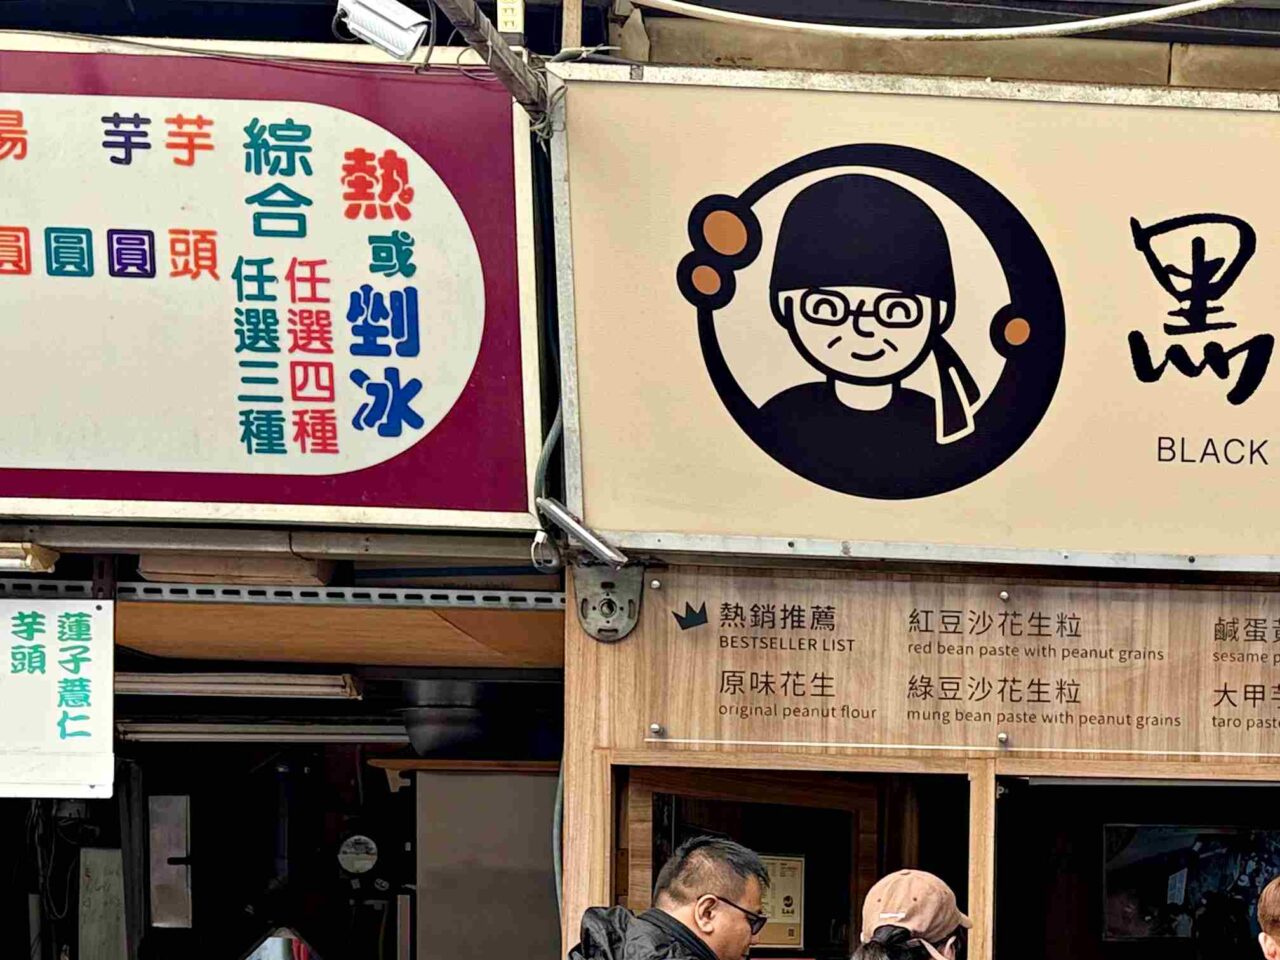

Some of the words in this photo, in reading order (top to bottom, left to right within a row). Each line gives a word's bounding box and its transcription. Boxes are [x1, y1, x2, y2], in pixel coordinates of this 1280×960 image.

[243, 118, 313, 238] 綜合
[340, 147, 425, 439] 熱或剉冰
[232, 256, 287, 455] 任選三種
[285, 257, 339, 454] 任選四種
[1157, 436, 1269, 466] BLACK
[719, 602, 836, 632] 熱銷推薦
[908, 608, 1082, 639] 紅豆沙花生粒
[10, 610, 46, 675] 芋頭
[720, 636, 817, 652] BESTSELLER
[823, 638, 855, 652] LIST
[908, 642, 931, 656] red
[936, 642, 974, 657] bean
[980, 644, 1019, 659] paste
[1024, 643, 1056, 658] with
[1061, 646, 1113, 661] peanut
[1118, 646, 1164, 662] grains
[1212, 652, 1268, 664] sesame
[57, 611, 93, 740] 蓮子薏仁
[719, 669, 836, 699] 原味花生
[907, 675, 1082, 705] 綠豆沙花生粒
[718, 703, 777, 720] original
[782, 705, 836, 720] peanut
[840, 704, 876, 719] flour
[907, 710, 950, 725] mung
[955, 709, 992, 724] bean
[996, 711, 1036, 726] paste
[1040, 711, 1074, 725] with
[1078, 713, 1132, 728] peanut
[1136, 714, 1182, 729] grains
[1212, 717, 1242, 730] taro
